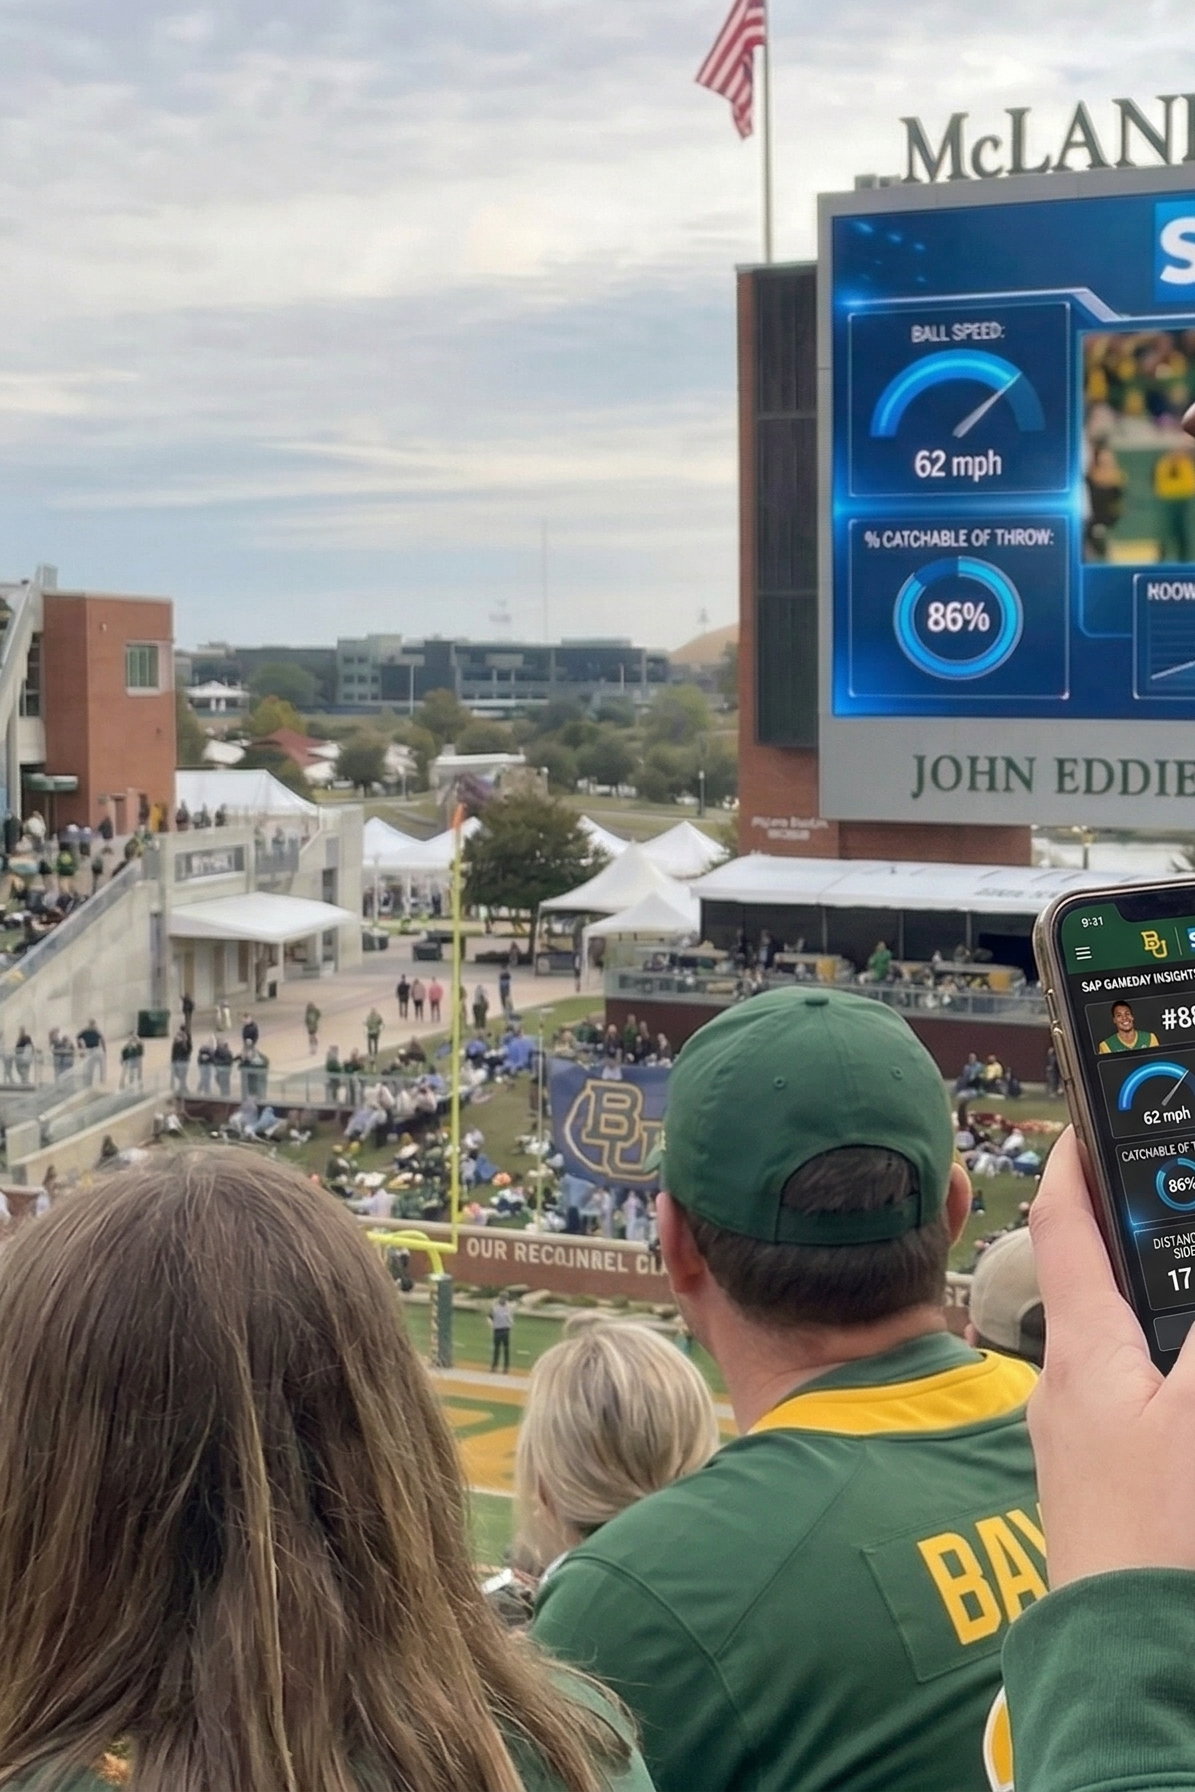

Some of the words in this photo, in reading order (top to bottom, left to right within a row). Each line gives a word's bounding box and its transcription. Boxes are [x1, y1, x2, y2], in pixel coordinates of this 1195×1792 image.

[911, 325, 950, 343] BALL
[952, 322, 1006, 340] SPEED:
[914, 450, 947, 478] 62
[952, 449, 1003, 482] mph
[882, 530, 968, 548] CATCHABLE
[971, 529, 991, 546] OF
[994, 527, 1055, 546] THROW:
[927, 601, 990, 632] 86%
[911, 754, 1036, 799] JOHN
[1081, 981, 1102, 993] SAP
[1104, 973, 1152, 991] GAMEDAY
[1143, 1111, 1162, 1126] 62
[1163, 1105, 1192, 1124] mph
[1177, 1141, 1190, 1154] OF
[466, 1237, 508, 1261] OUR
[1167, 1267, 1192, 1292] 17
